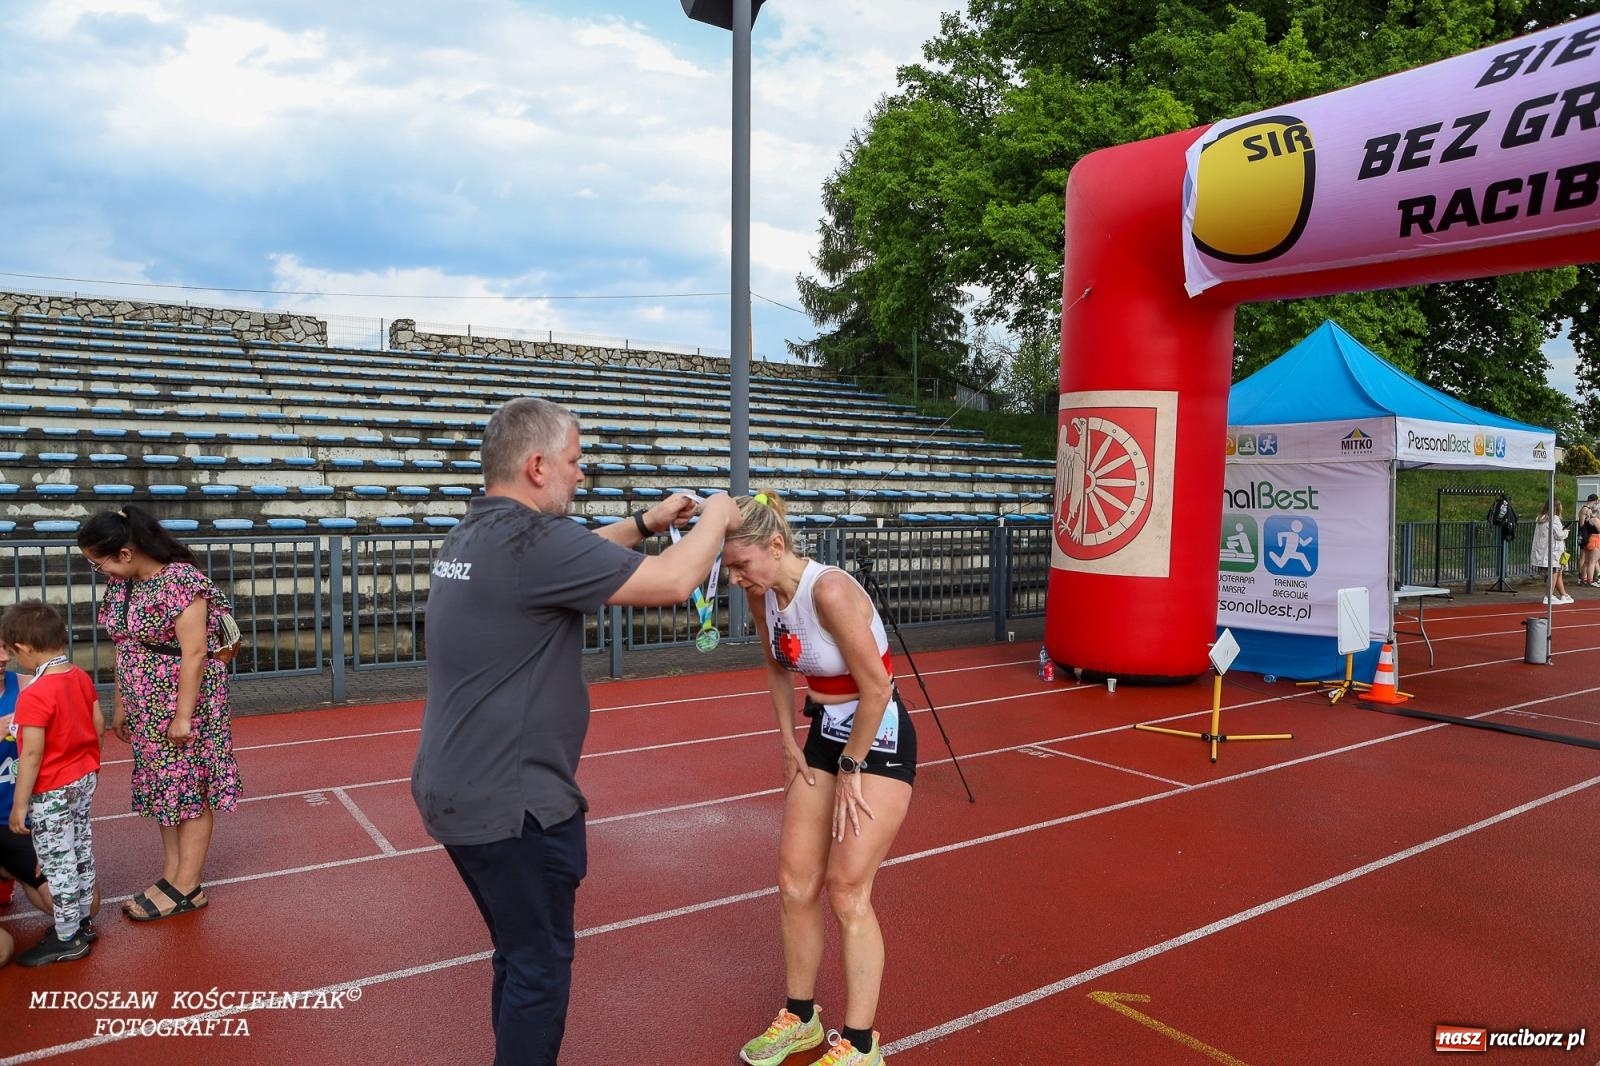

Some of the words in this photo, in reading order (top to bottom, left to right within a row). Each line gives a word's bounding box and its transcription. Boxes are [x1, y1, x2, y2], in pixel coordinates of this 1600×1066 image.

[1357, 110, 1491, 181] BEZ
[1500, 80, 1600, 150] GR
[1243, 125, 1313, 162] SIR
[1341, 439, 1373, 451] MITKO
[1408, 430, 1471, 453] PersonalBest
[1274, 578, 1308, 589] TRENINGI
[1272, 589, 1309, 600] BIEGOWE
